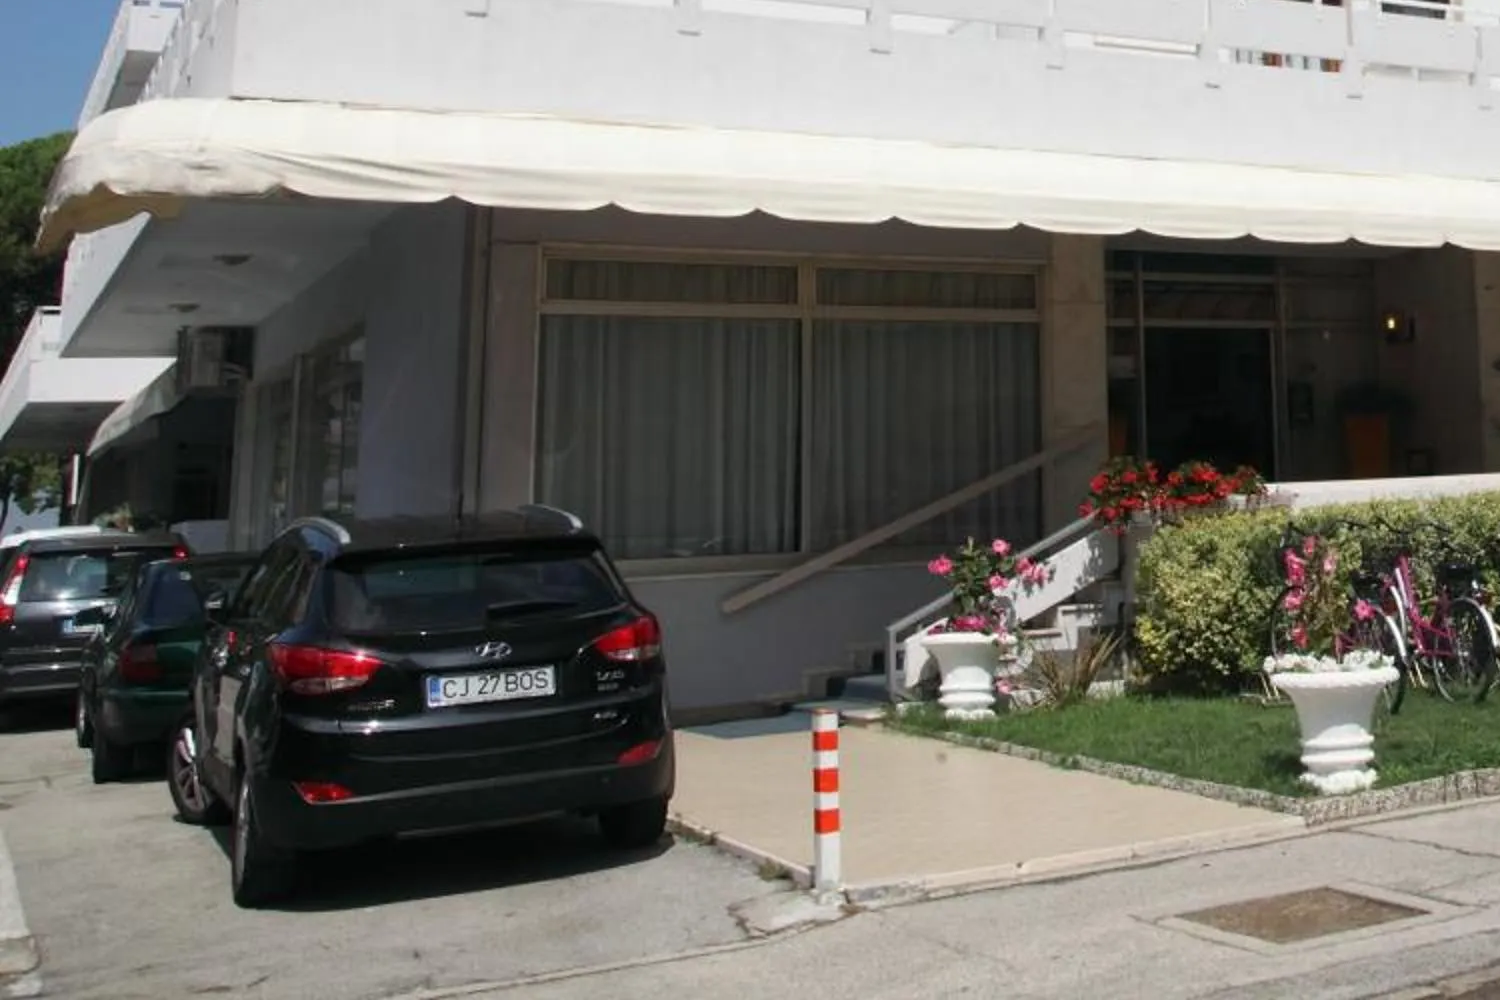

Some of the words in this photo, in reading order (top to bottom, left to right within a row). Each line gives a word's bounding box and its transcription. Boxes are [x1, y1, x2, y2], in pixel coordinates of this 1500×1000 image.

[443, 679, 470, 699] CJ
[478, 675, 500, 696] 27
[505, 670, 549, 693] BOS
